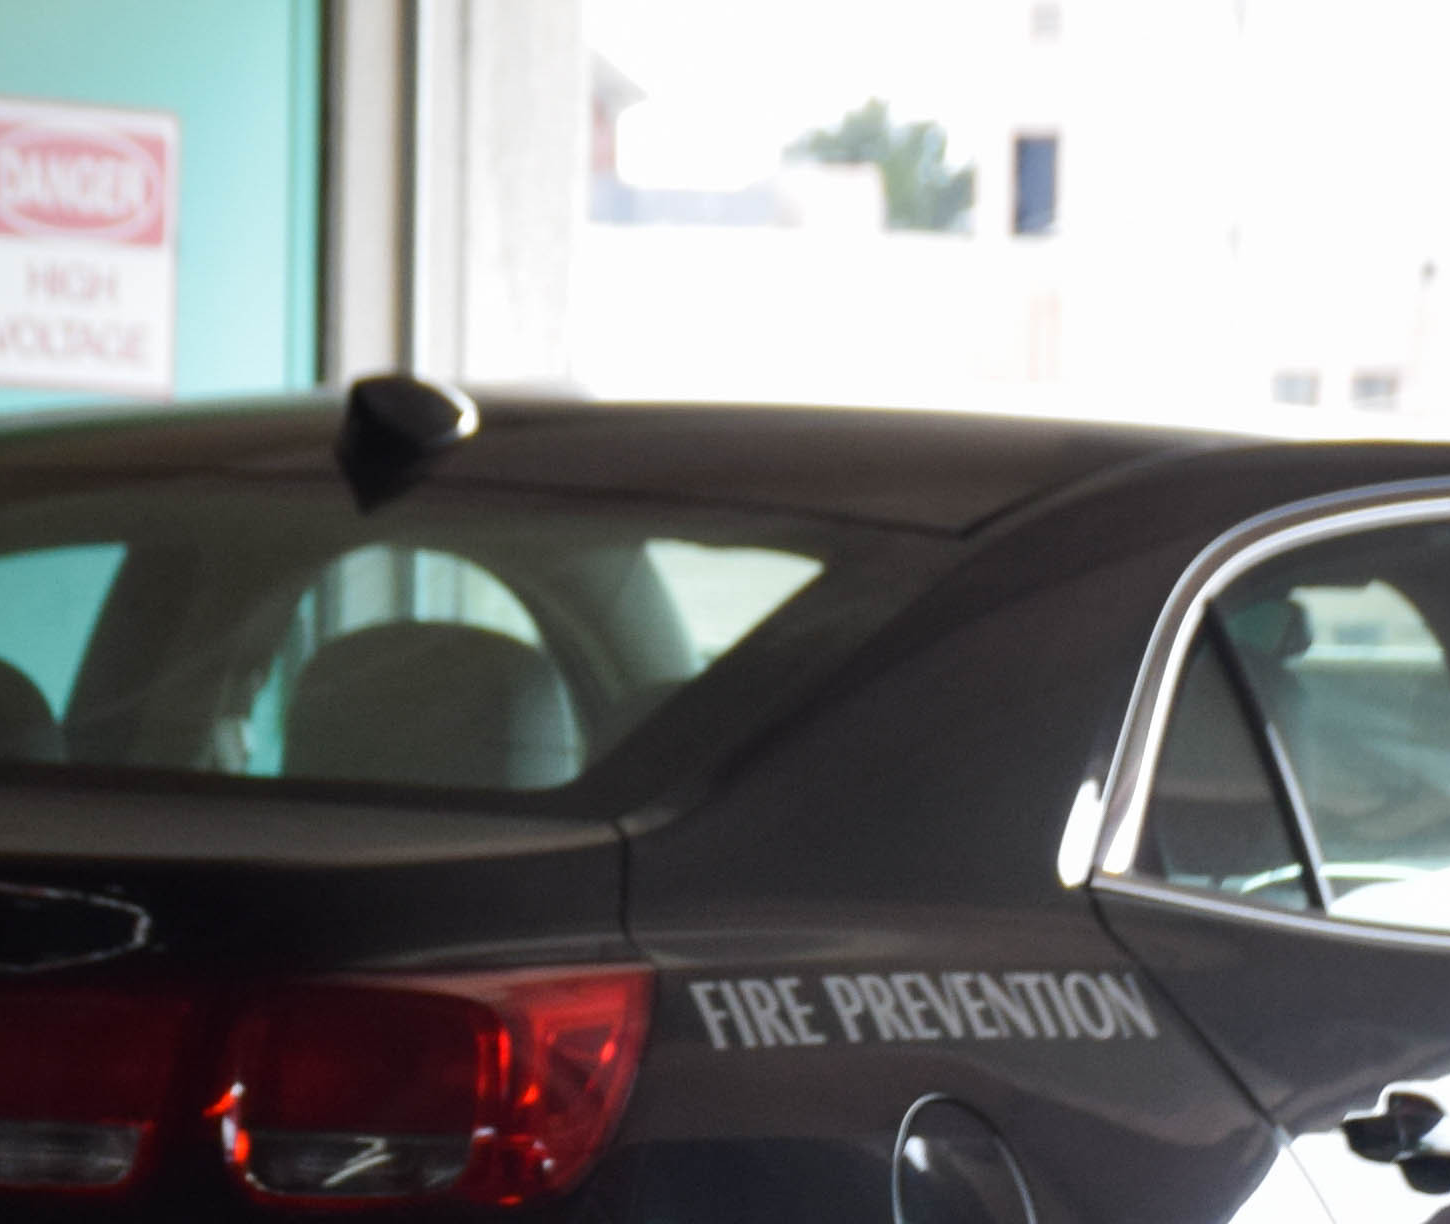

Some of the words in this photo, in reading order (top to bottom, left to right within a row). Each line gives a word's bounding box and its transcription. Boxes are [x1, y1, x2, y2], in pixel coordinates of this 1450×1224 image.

[25, 261, 121, 305] HIGH
[689, 976, 827, 1050] FIRE
[821, 971, 1158, 1041] PREVENTION
